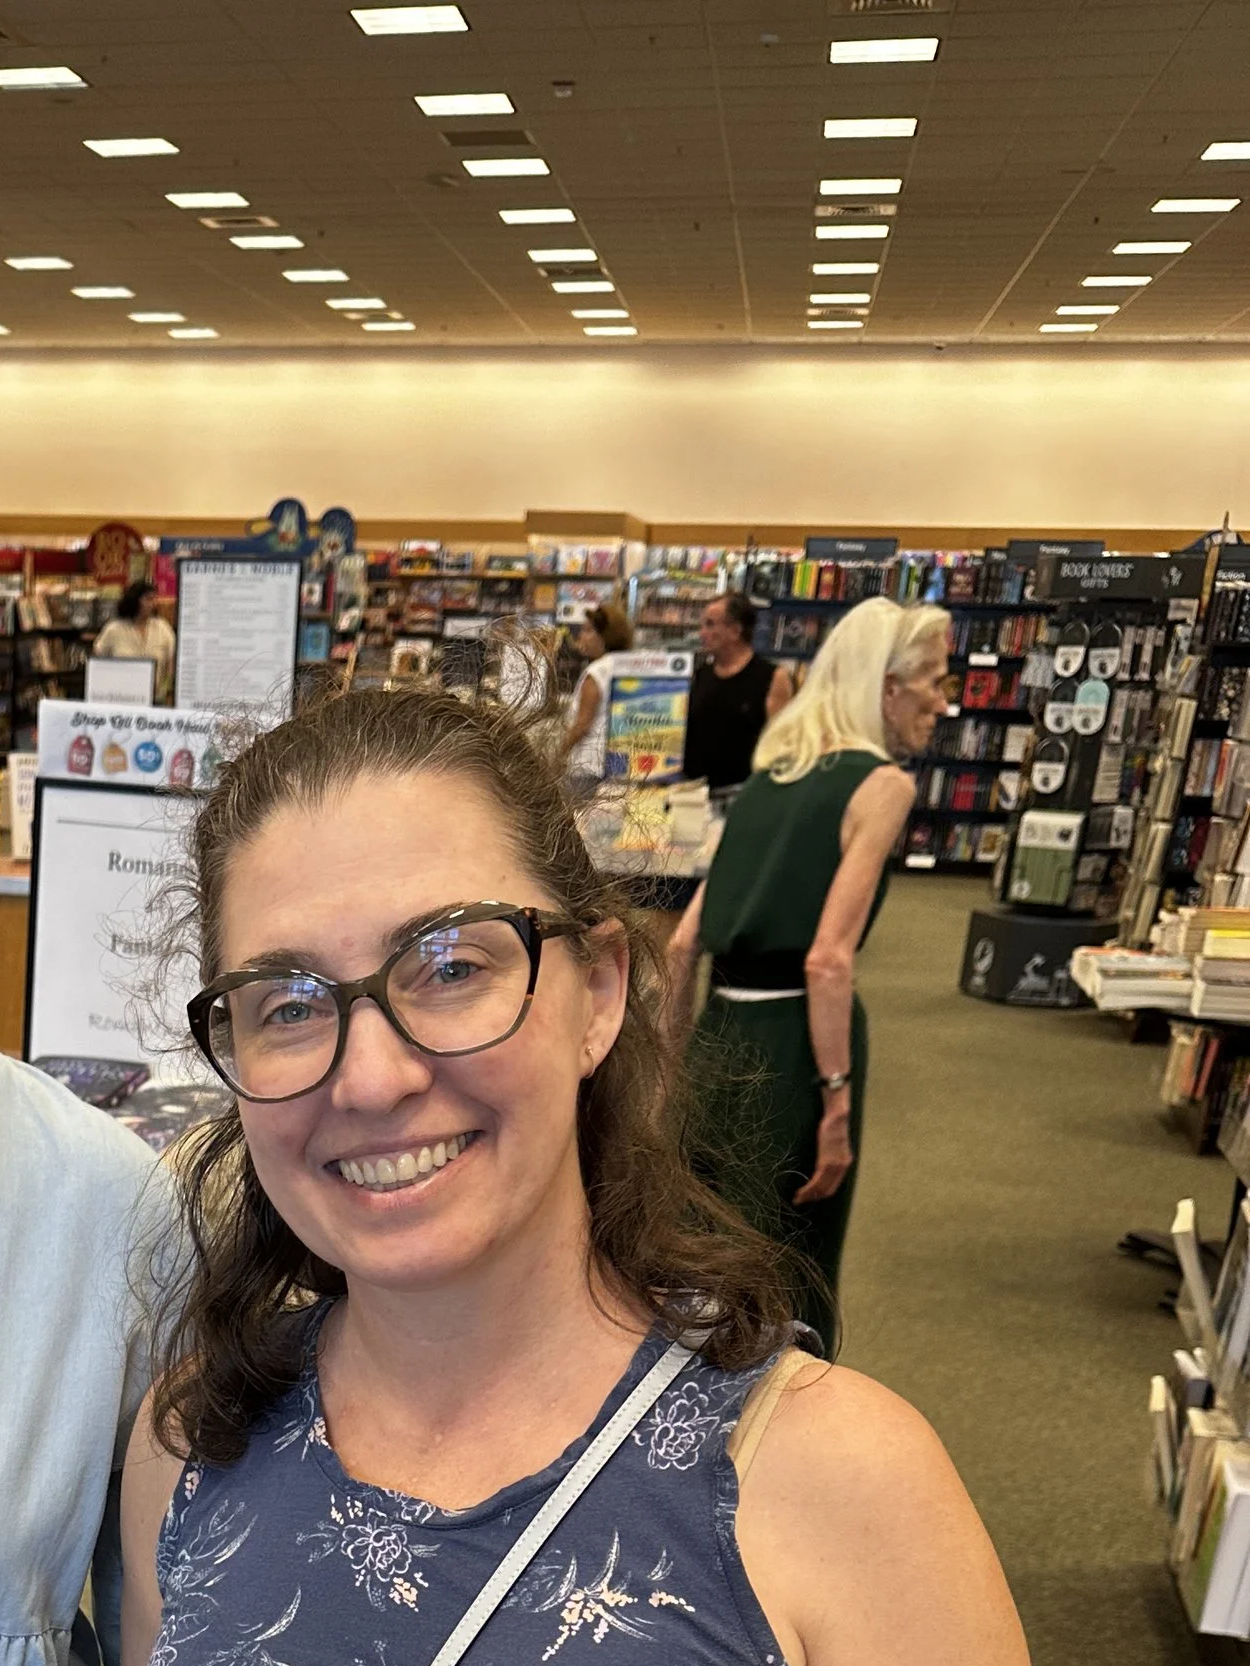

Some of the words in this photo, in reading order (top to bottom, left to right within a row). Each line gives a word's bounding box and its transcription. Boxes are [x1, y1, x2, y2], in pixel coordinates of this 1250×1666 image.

[1060, 562, 1091, 578] BOOK
[1080, 579, 1110, 589] GIFTS
[70, 711, 106, 730] Shop
